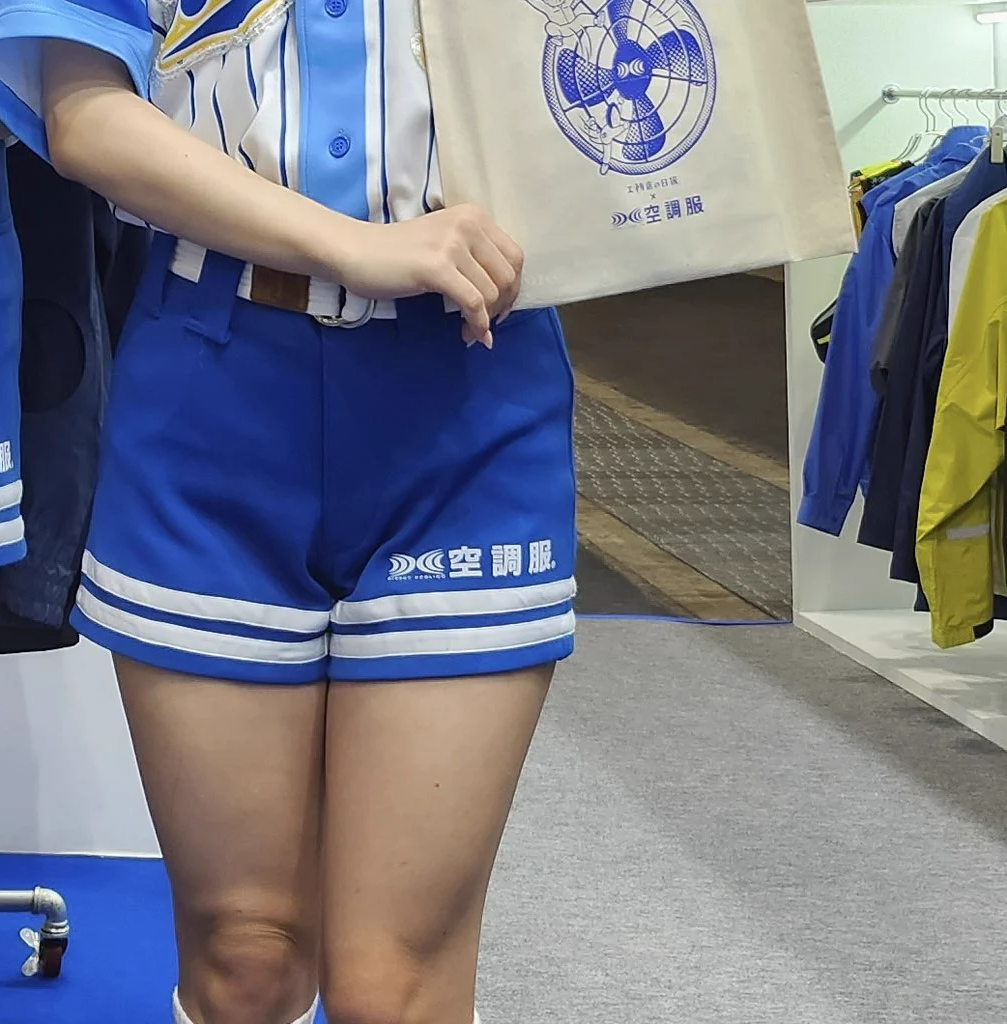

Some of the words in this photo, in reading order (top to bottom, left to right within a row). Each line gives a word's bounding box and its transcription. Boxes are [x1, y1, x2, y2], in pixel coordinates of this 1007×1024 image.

[643, 195, 705, 225] 空調服
[448, 539, 551, 578] 空調服
